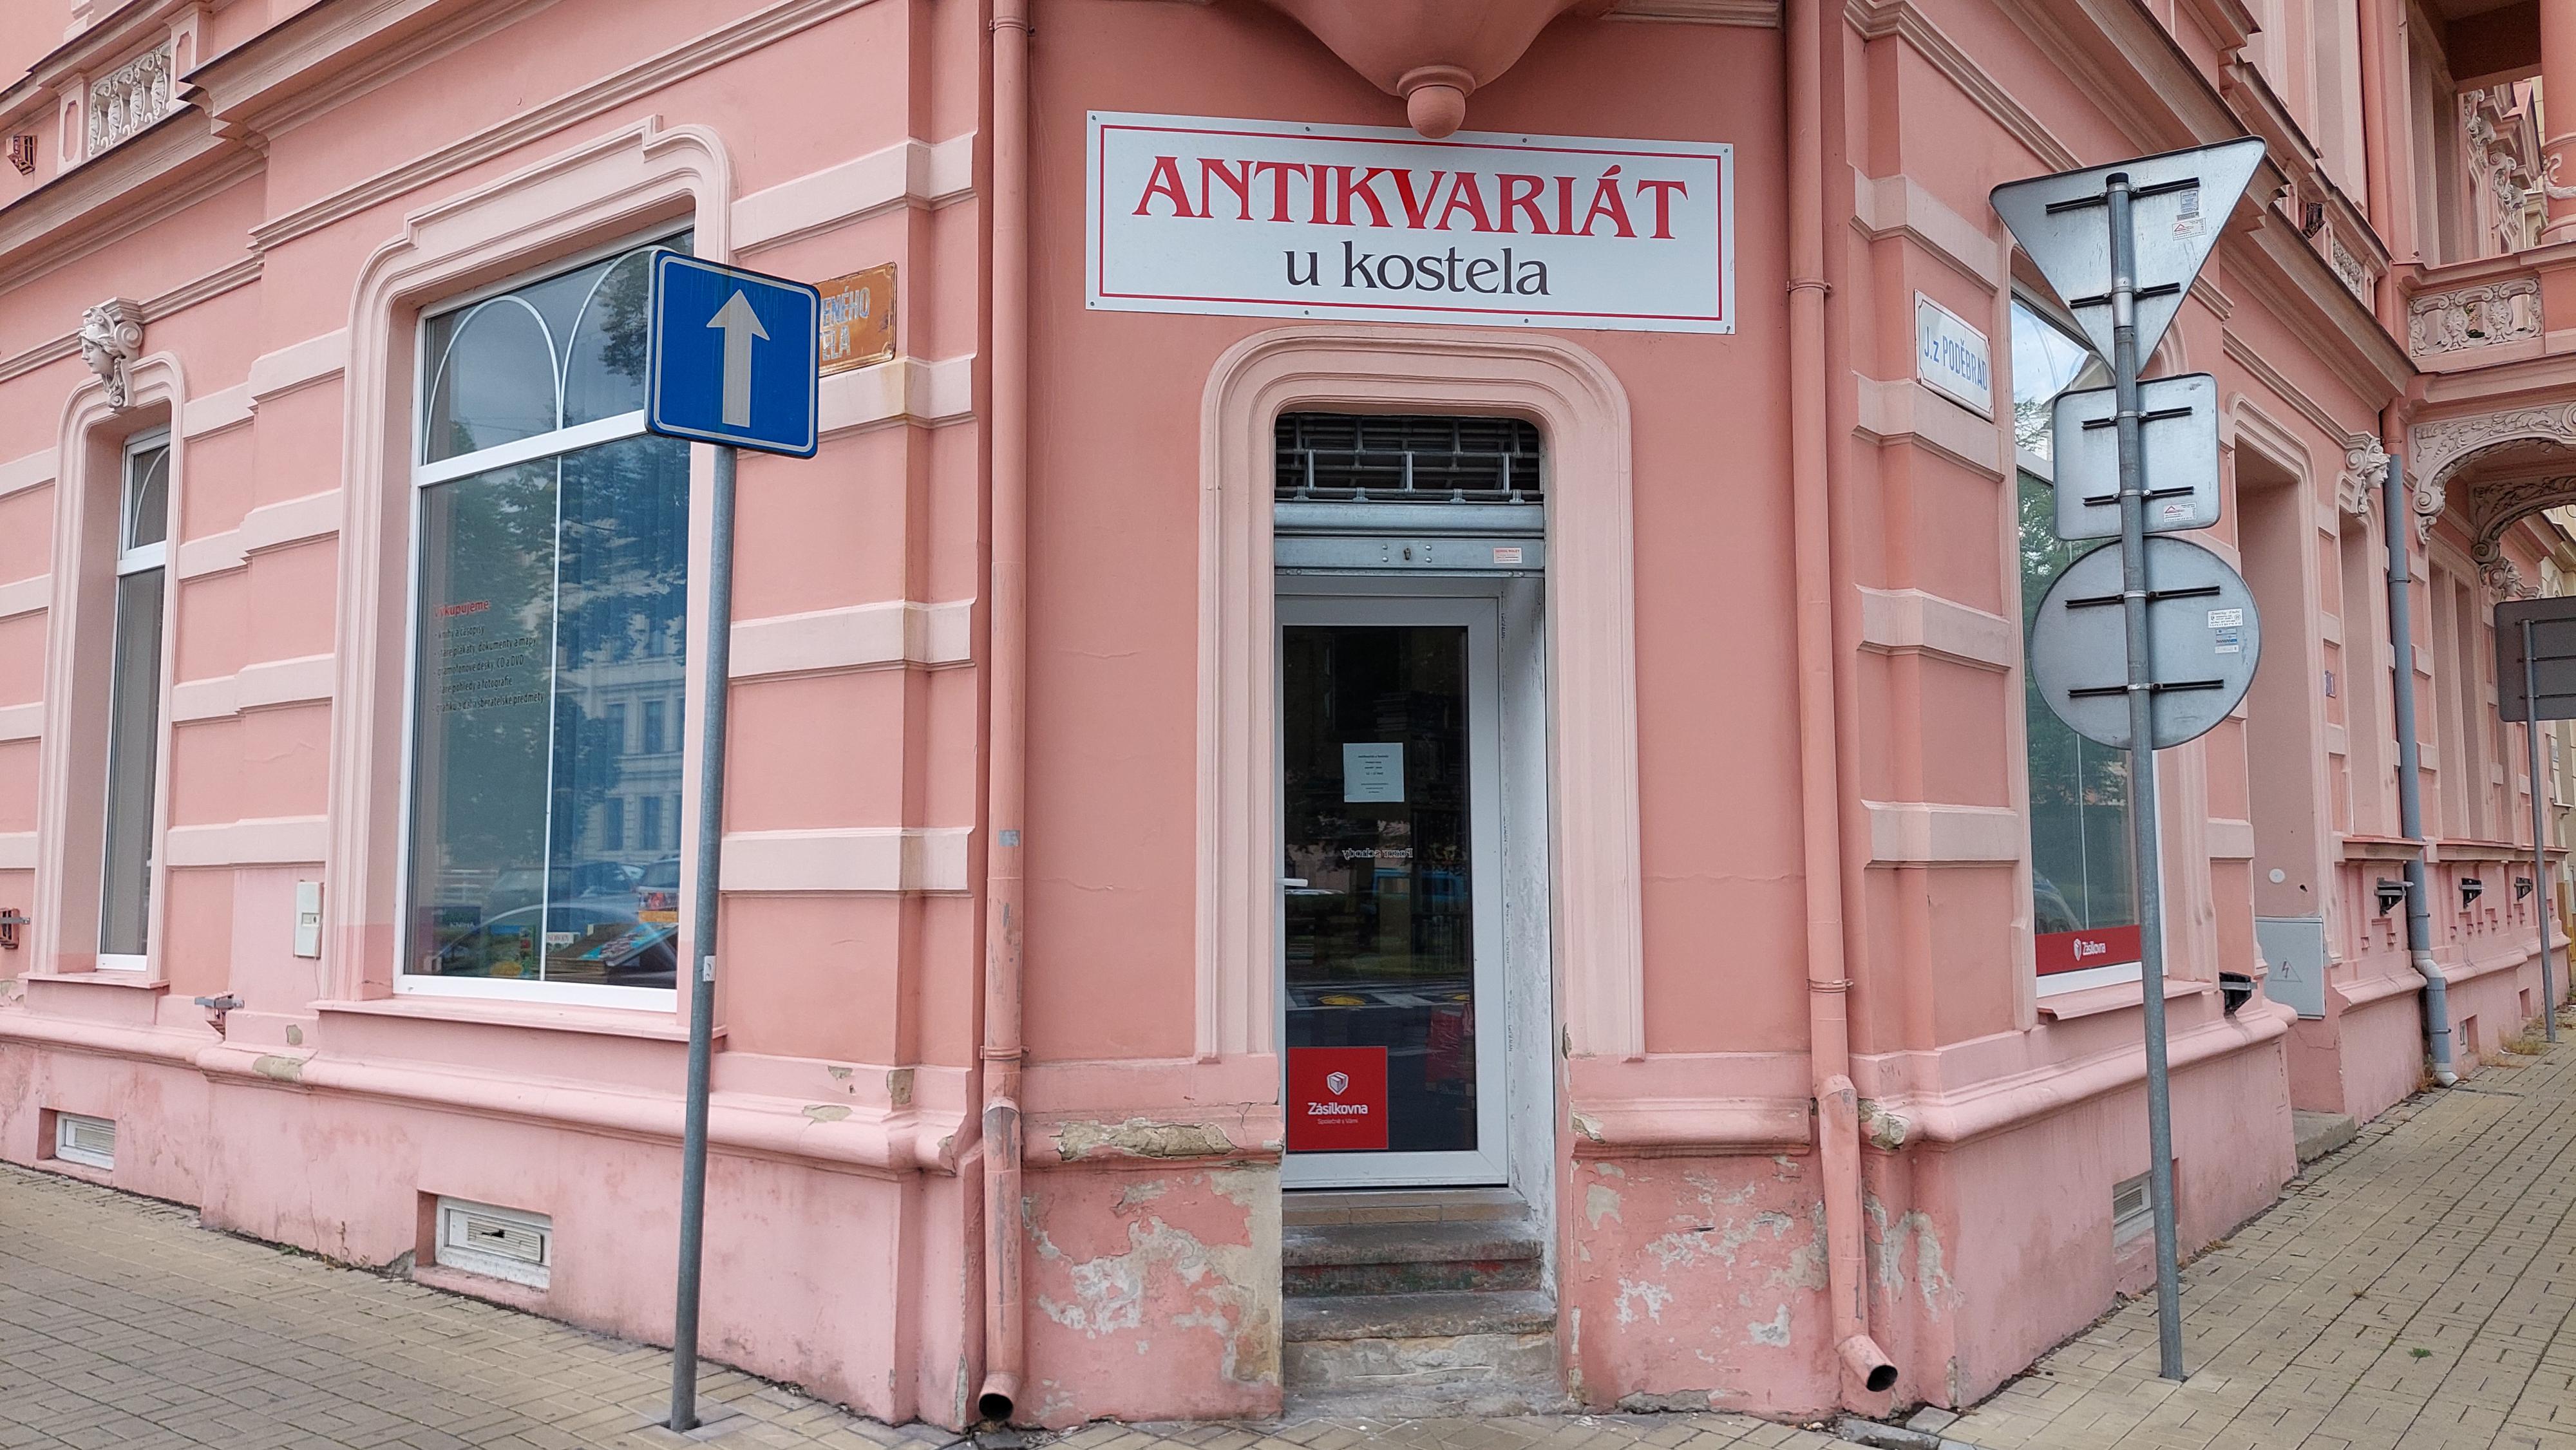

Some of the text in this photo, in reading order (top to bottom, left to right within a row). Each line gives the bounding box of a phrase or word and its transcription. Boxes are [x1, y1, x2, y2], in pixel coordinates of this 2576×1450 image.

[1132, 155, 1689, 240] ANTIKVARIÁT
[1283, 240, 1551, 296] u kostela
[820, 286, 869, 328] ENÉHO
[1942, 335, 1988, 391] PODĚBRAD
[511, 654, 524, 666] DVD
[1307, 1102, 1368, 1115] Zásilkovna
